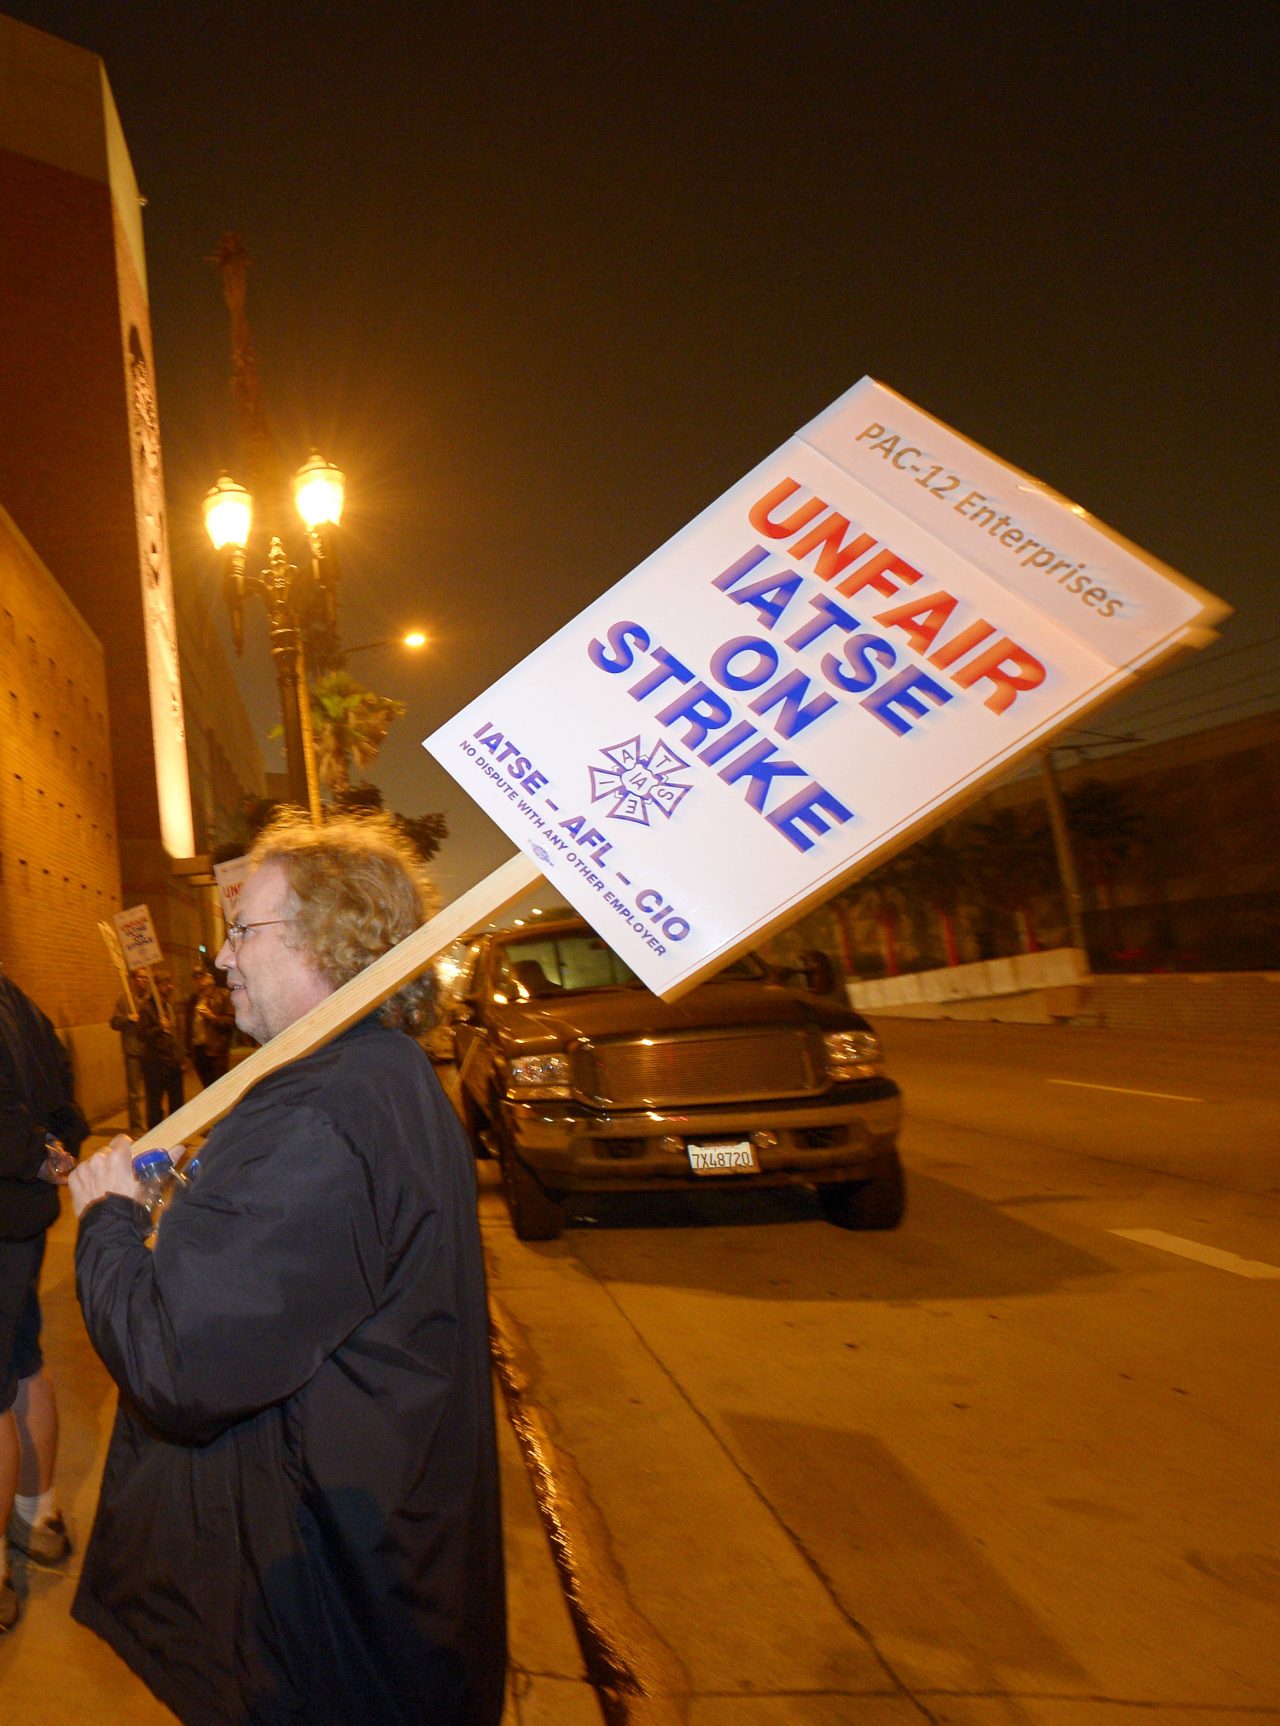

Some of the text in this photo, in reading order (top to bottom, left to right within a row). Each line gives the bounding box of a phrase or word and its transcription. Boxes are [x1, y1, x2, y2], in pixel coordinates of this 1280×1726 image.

[748, 476, 1047, 716] UNFAIR
[854, 422, 1124, 618] PAC-12 Enterprises
[587, 620, 856, 854] STRIKE
[710, 545, 956, 737] IATSE
[710, 633, 838, 742] ON
[459, 740, 476, 757] NO
[474, 756, 518, 801] DISPUTE
[517, 799, 546, 829] WITH
[542, 829, 569, 851] ANY
[566, 852, 605, 892] OTHER
[602, 891, 667, 957] EMPLOYER
[473, 721, 549, 796] IATSE
[558, 815, 613, 868] AFL
[635, 888, 690, 942] CIO
[691, 1151, 751, 1169] 7X48720
